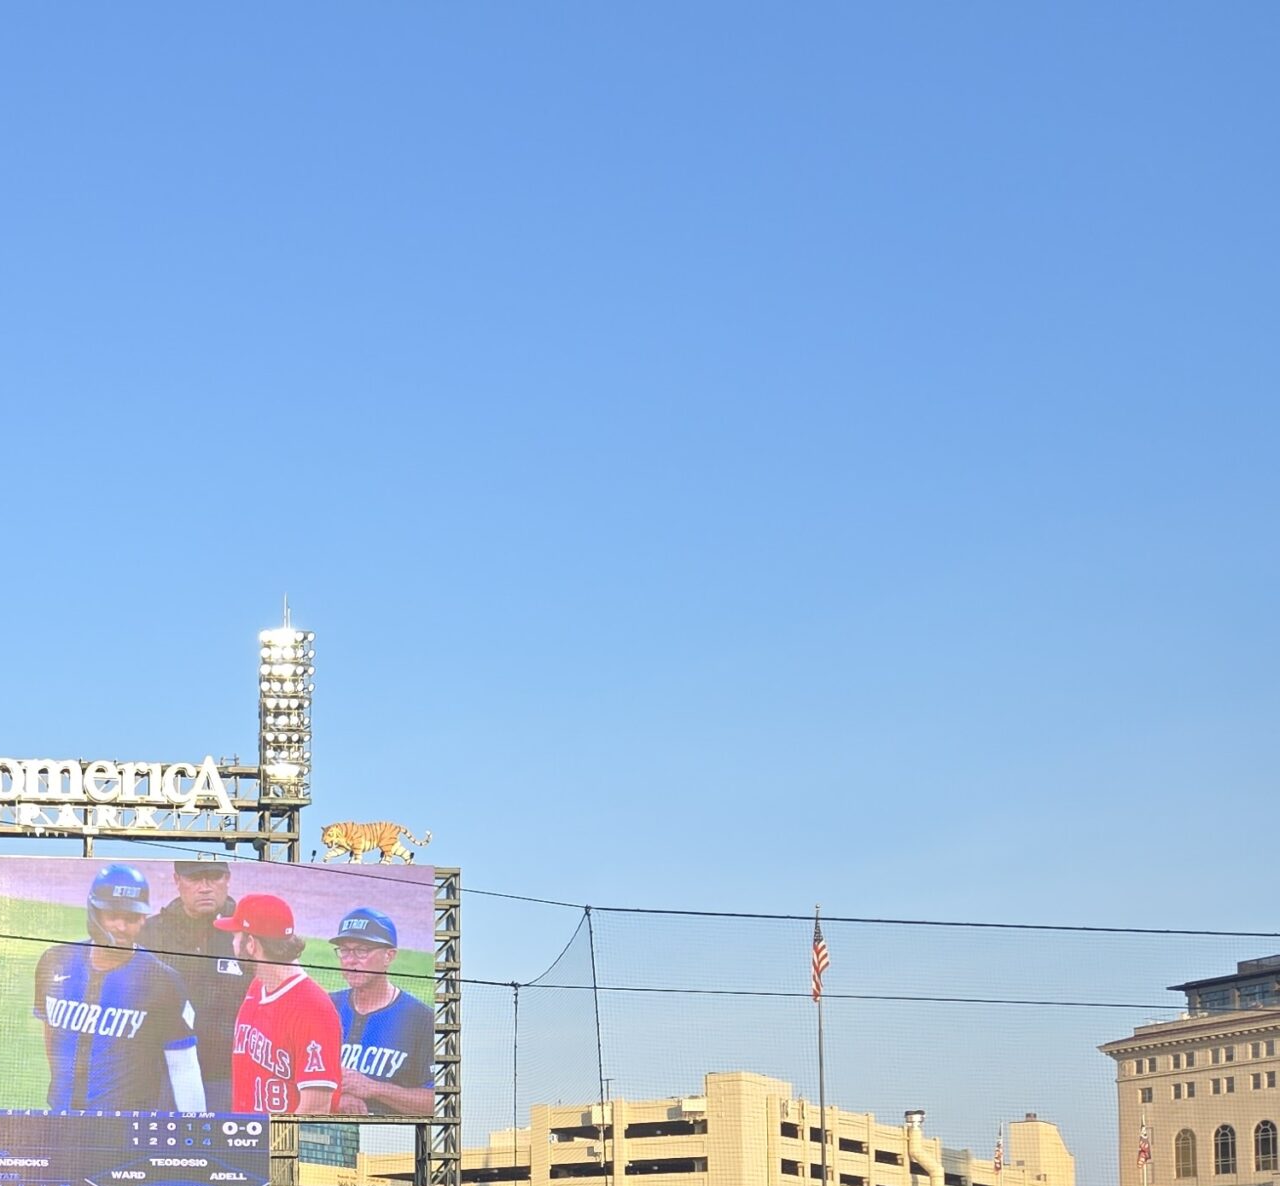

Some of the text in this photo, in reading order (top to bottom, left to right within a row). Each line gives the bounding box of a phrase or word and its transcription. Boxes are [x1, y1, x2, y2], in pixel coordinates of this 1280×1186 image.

[20, 804, 159, 828] PARK
[341, 918, 369, 931] DETROIT
[99, 1006, 147, 1039] CITY
[233, 1022, 292, 1080] NGELS
[360, 1047, 408, 1078] CITY
[253, 1077, 289, 1112] 18
[149, 1122, 158, 1130] 2
[167, 1122, 176, 1130] 0
[222, 1121, 263, 1135] 0-0
[149, 1137, 158, 1145] 2
[167, 1137, 176, 1146] 0
[149, 1158, 208, 1167] TEODOSIO
[111, 1171, 146, 1180] WARD
[209, 1172, 247, 1181] ADELL
